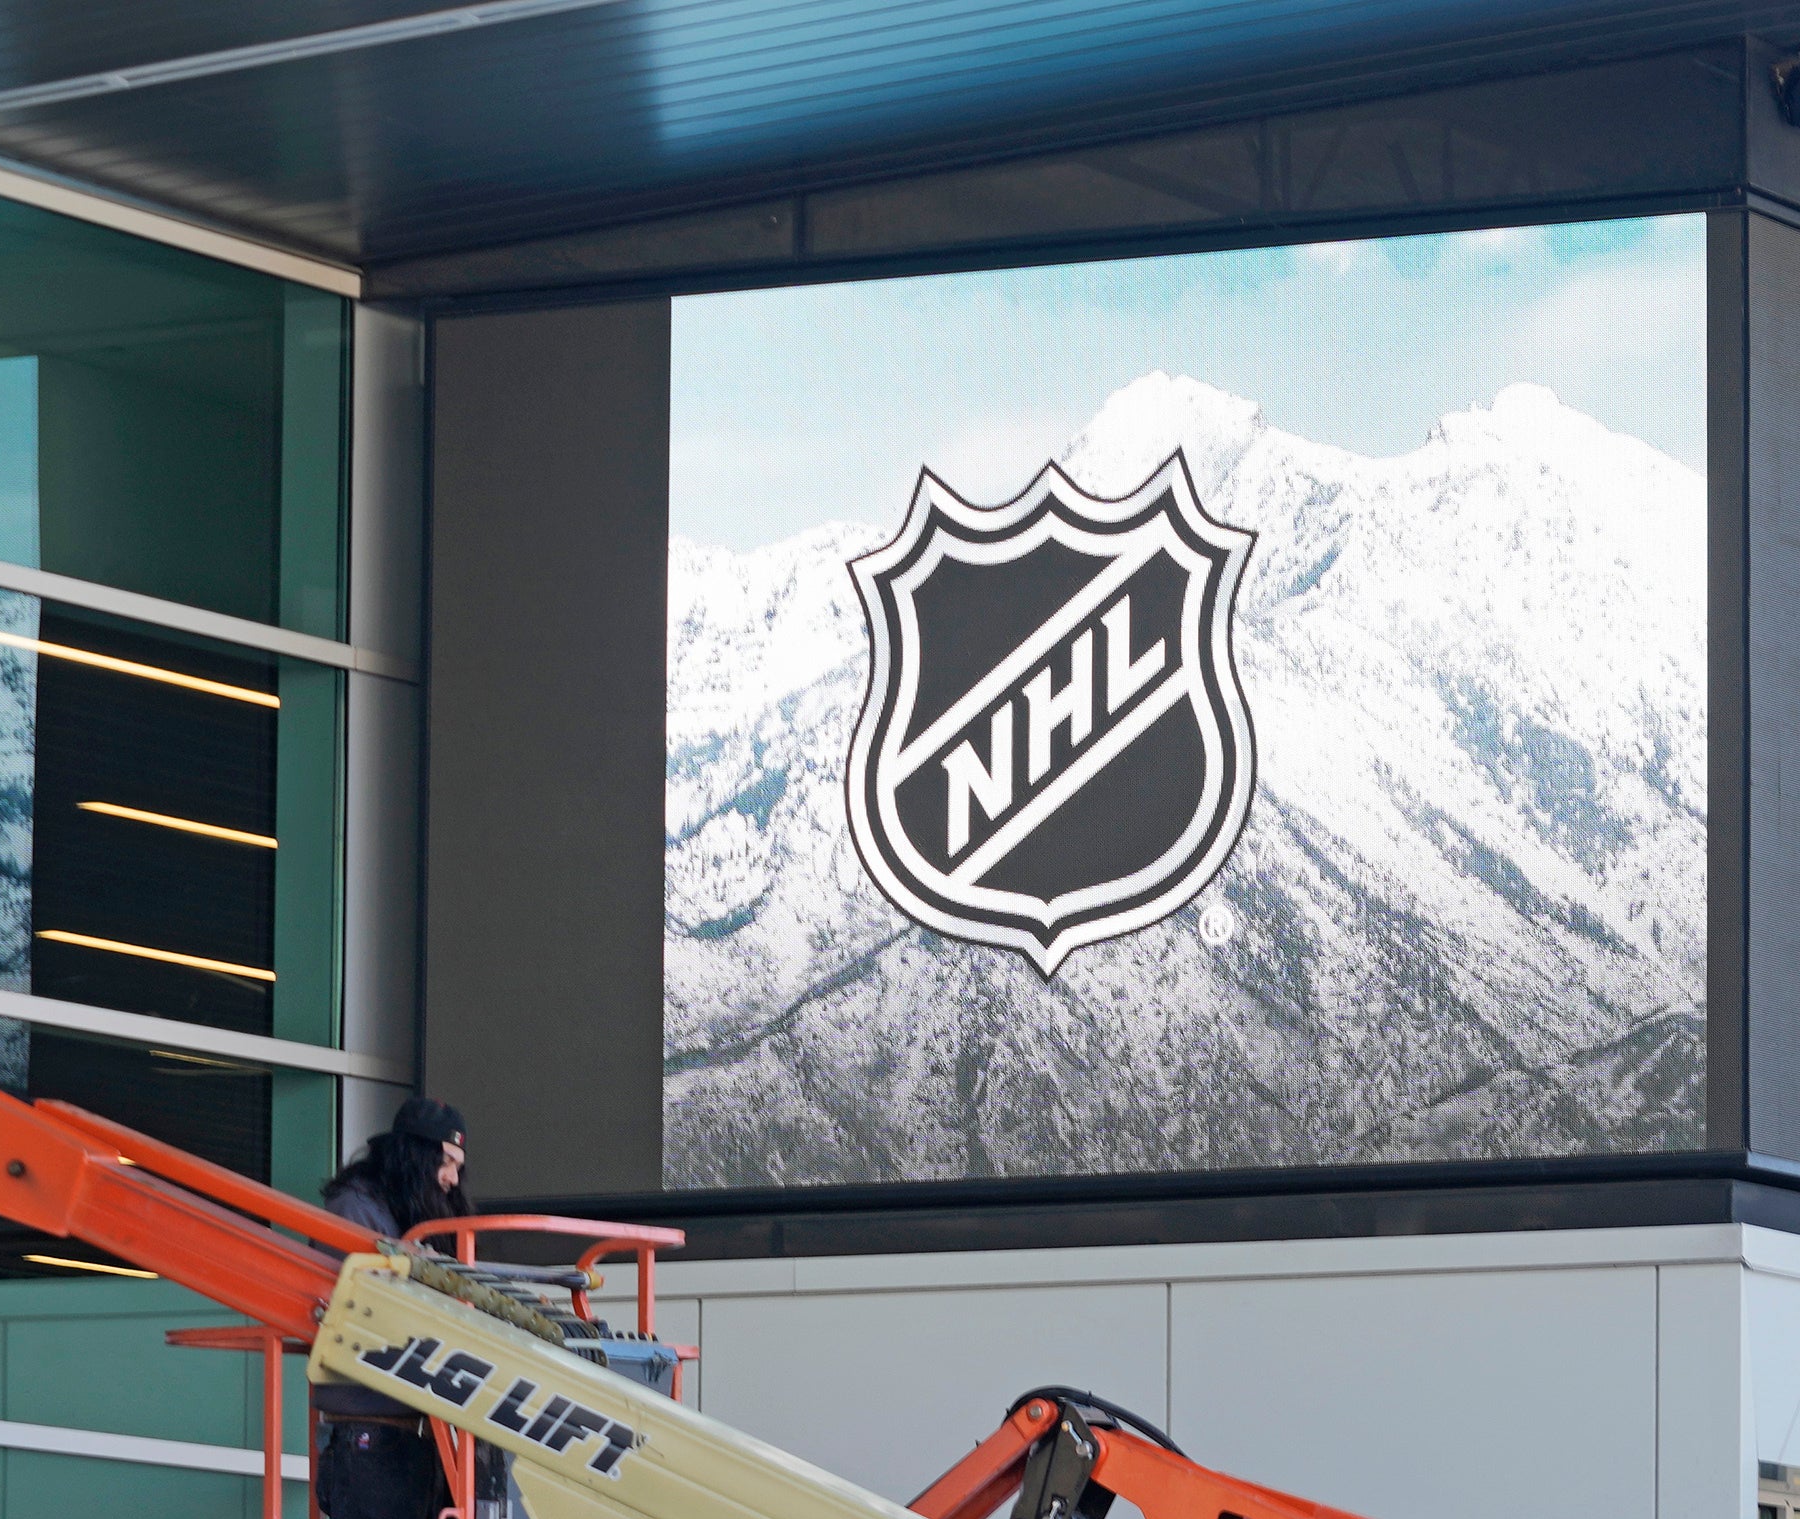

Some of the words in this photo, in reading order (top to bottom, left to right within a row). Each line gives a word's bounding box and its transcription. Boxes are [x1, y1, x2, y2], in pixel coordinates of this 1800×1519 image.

[941, 594, 1166, 858] NHL
[355, 1335, 497, 1411] JLG
[483, 1375, 650, 1479] LIFT
